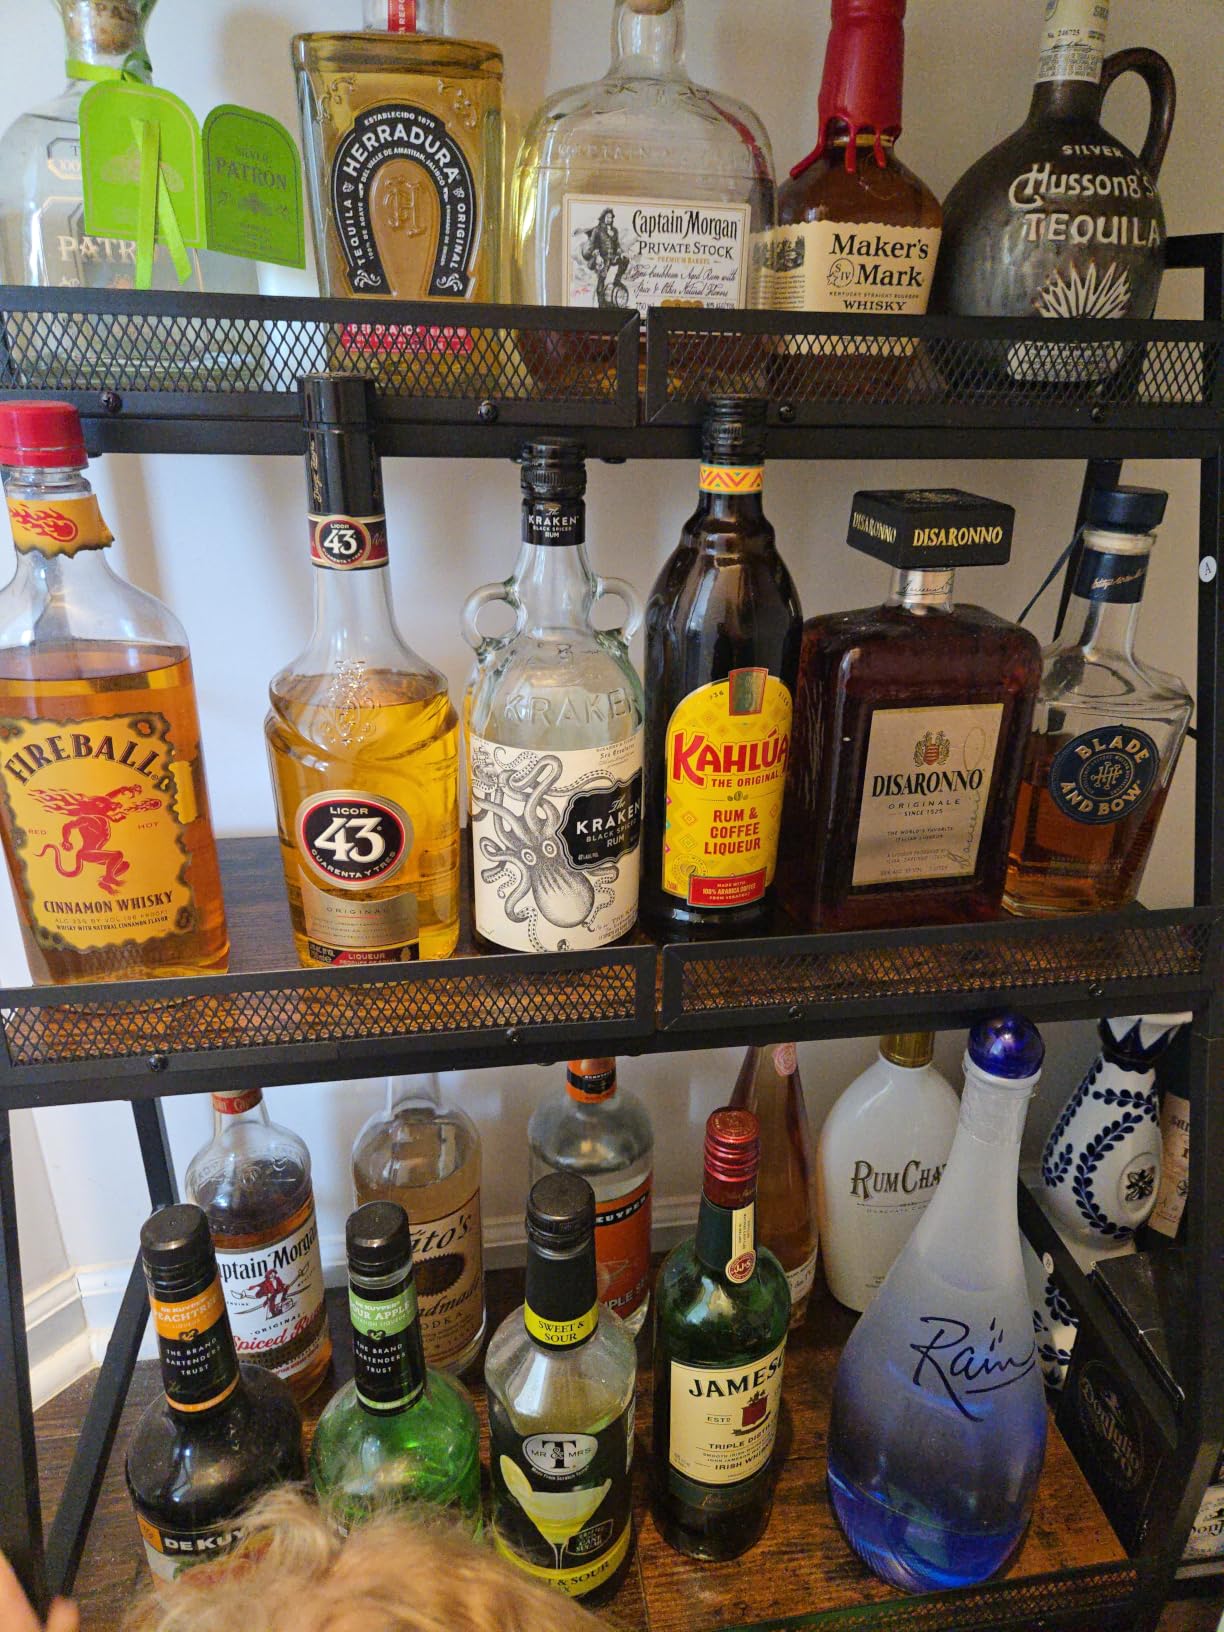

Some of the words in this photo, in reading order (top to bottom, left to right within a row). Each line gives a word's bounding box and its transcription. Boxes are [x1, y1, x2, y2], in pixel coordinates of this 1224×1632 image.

[363, 111, 415, 126] ESTABLECIDO
[417, 115, 435, 129] 1870
[342, 123, 460, 184] HERRADURA
[1062, 145, 1124, 158] SILVER
[366, 152, 384, 170] VALLE
[383, 148, 394, 158] DE
[425, 160, 446, 187] JALISCO
[357, 201, 366, 226] AGAVE
[343, 199, 366, 267] TEQUILA
[632, 209, 683, 238] Captain
[683, 210, 738, 241] Morgan
[1024, 213, 1161, 246] TEQUILA
[450, 203, 467, 269] ORIGINAL
[828, 233, 929, 259] Maker's
[57, 235, 137, 263] PATR
[638, 240, 691, 256] PRIVATE
[693, 241, 734, 260] STOCK
[855, 263, 922, 287] Mark
[843, 300, 907, 311] WHISKY
[529, 516, 578, 526] KRAKEN
[853, 512, 897, 544] DISARONNO
[324, 529, 357, 555] 43
[545, 531, 560, 539] RUM
[912, 526, 1003, 548] DISARONNO
[4, 733, 160, 785] FIREBALL
[672, 728, 789, 786] KAHLÚA
[1075, 736, 1150, 763] BLADE
[711, 777, 732, 788] THE
[737, 770, 779, 787] ORIGINAL
[872, 768, 983, 798] DISARONNO
[888, 799, 960, 809] ORIGINALE
[1060, 782, 1094, 812] AND
[1097, 783, 1142, 815] BOW
[330, 806, 369, 815] LICOR
[576, 799, 640, 835] KRAKEN
[713, 808, 744, 823] RUM
[749, 806, 759, 819] &
[28, 828, 47, 836] RED
[138, 821, 159, 831] HOT
[710, 822, 760, 839] COFFEE
[314, 817, 386, 863] 43
[586, 830, 614, 843] BLACK
[607, 833, 625, 848] RUM
[704, 837, 761, 855] LIQUEUR
[311, 849, 363, 878] CUARENTA
[374, 851, 397, 872] TRES
[44, 900, 113, 915] CINNAMON
[116, 890, 173, 912] WHISKY
[57, 924, 76, 932] WHISKY
[93, 923, 118, 931] NATURAL
[118, 920, 147, 929] CINNAMON
[147, 916, 169, 926] FLAVOR
[348, 952, 385, 960] LIQUEUR
[411, 1214, 472, 1254] ito's
[219, 1257, 268, 1283] ptain
[375, 1301, 410, 1320] APPLE
[254, 1313, 301, 1335] ORIGINAL
[539, 1321, 576, 1333] SWEET
[577, 1321, 584, 1329] &
[166, 1349, 182, 1357] THE
[186, 1337, 217, 1356] BRAND
[233, 1330, 288, 1350] Spiced
[357, 1341, 369, 1352] THE
[372, 1343, 403, 1354] BRAND
[545, 1333, 577, 1343] SOUR
[181, 1364, 209, 1376] TRUST
[366, 1366, 392, 1374] TRUST
[910, 1317, 1037, 1422] Rain
[531, 1449, 547, 1457] MR
[568, 1447, 592, 1458] MRS
[542, 1440, 577, 1468] T
[709, 1440, 745, 1450] TRIPLE
[715, 1462, 742, 1470] IRISH
[571, 1561, 609, 1585] SOUR
